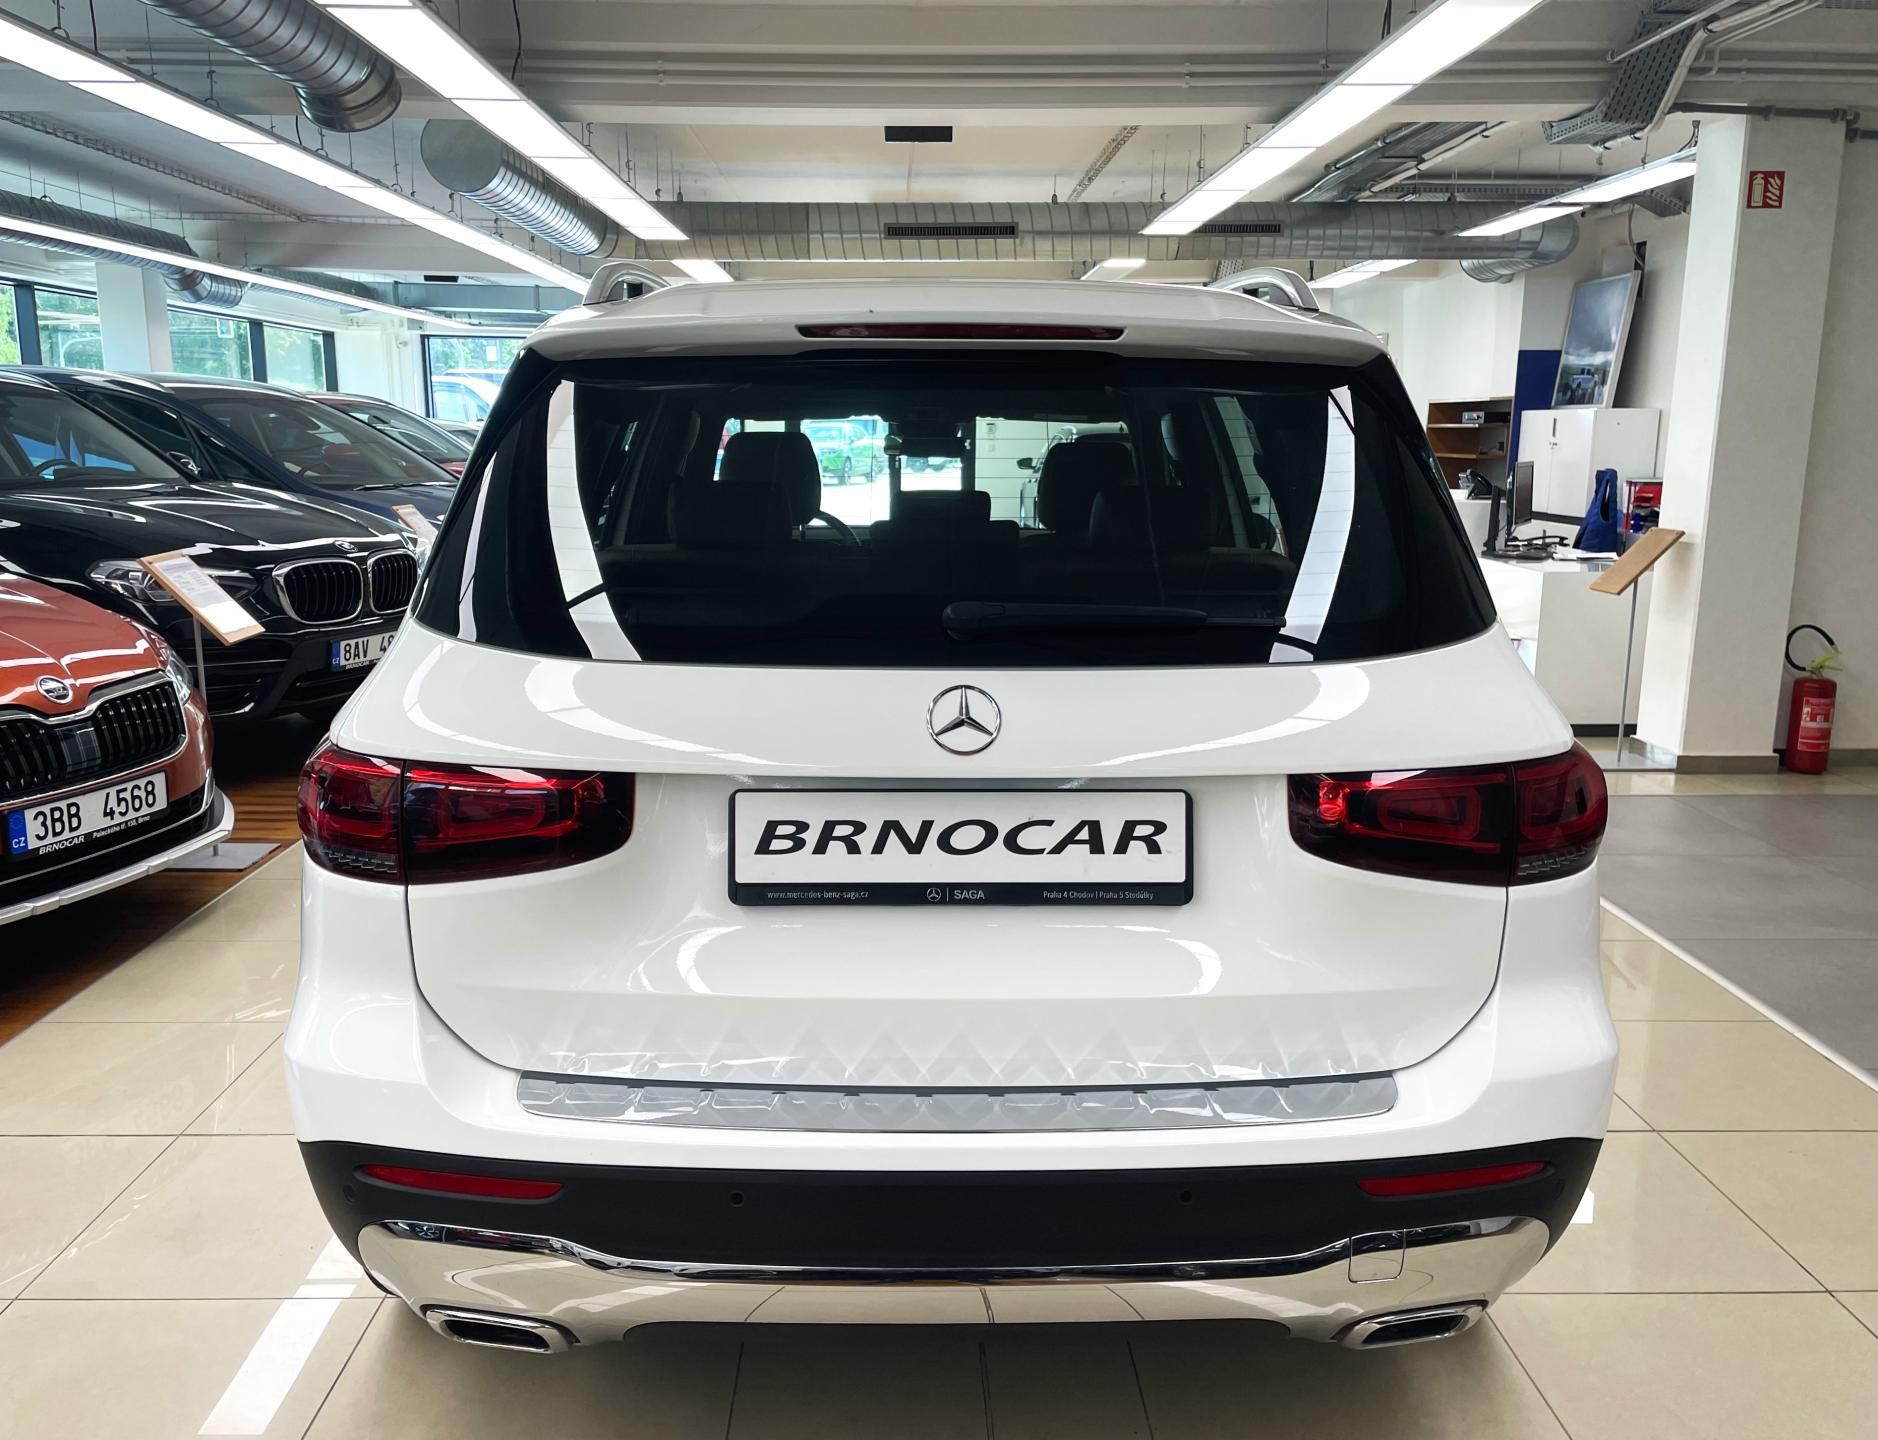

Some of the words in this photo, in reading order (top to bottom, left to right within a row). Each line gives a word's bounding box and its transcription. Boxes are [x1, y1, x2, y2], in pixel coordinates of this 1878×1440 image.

[344, 640, 369, 661] 8AV
[33, 802, 82, 841] 3BB
[103, 780, 156, 820] 4568
[12, 837, 26, 848] CZ
[39, 835, 85, 855] BRNOCAR
[754, 819, 1168, 856] BRNOCAR
[767, 890, 869, 900] www.mercedes-benz-saga.cz
[953, 889, 985, 900] SAGA
[1043, 890, 1062, 899] Praha
[1063, 890, 1068, 899] 4
[1099, 890, 1118, 899] Praha
[1119, 890, 1124, 899] 5
